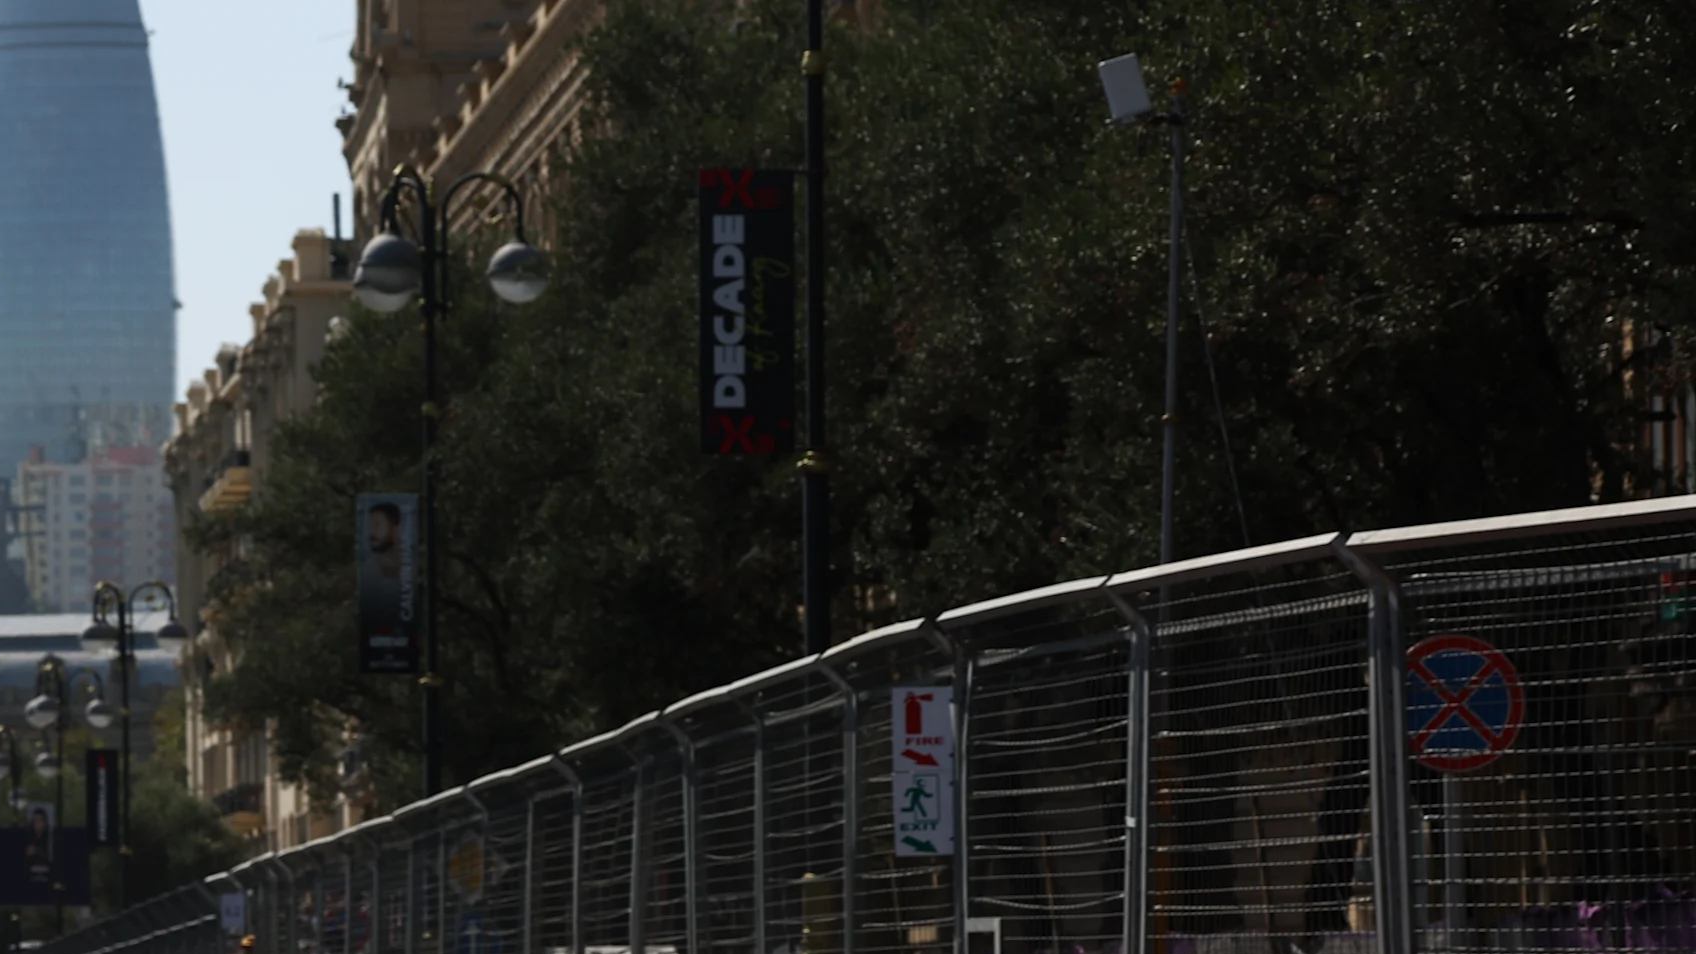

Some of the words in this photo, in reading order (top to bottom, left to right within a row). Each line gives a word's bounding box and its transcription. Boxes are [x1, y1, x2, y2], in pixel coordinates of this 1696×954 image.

[712, 213, 747, 409] DECADE
[906, 737, 944, 745] FIRE
[900, 822, 937, 831] EXIT
